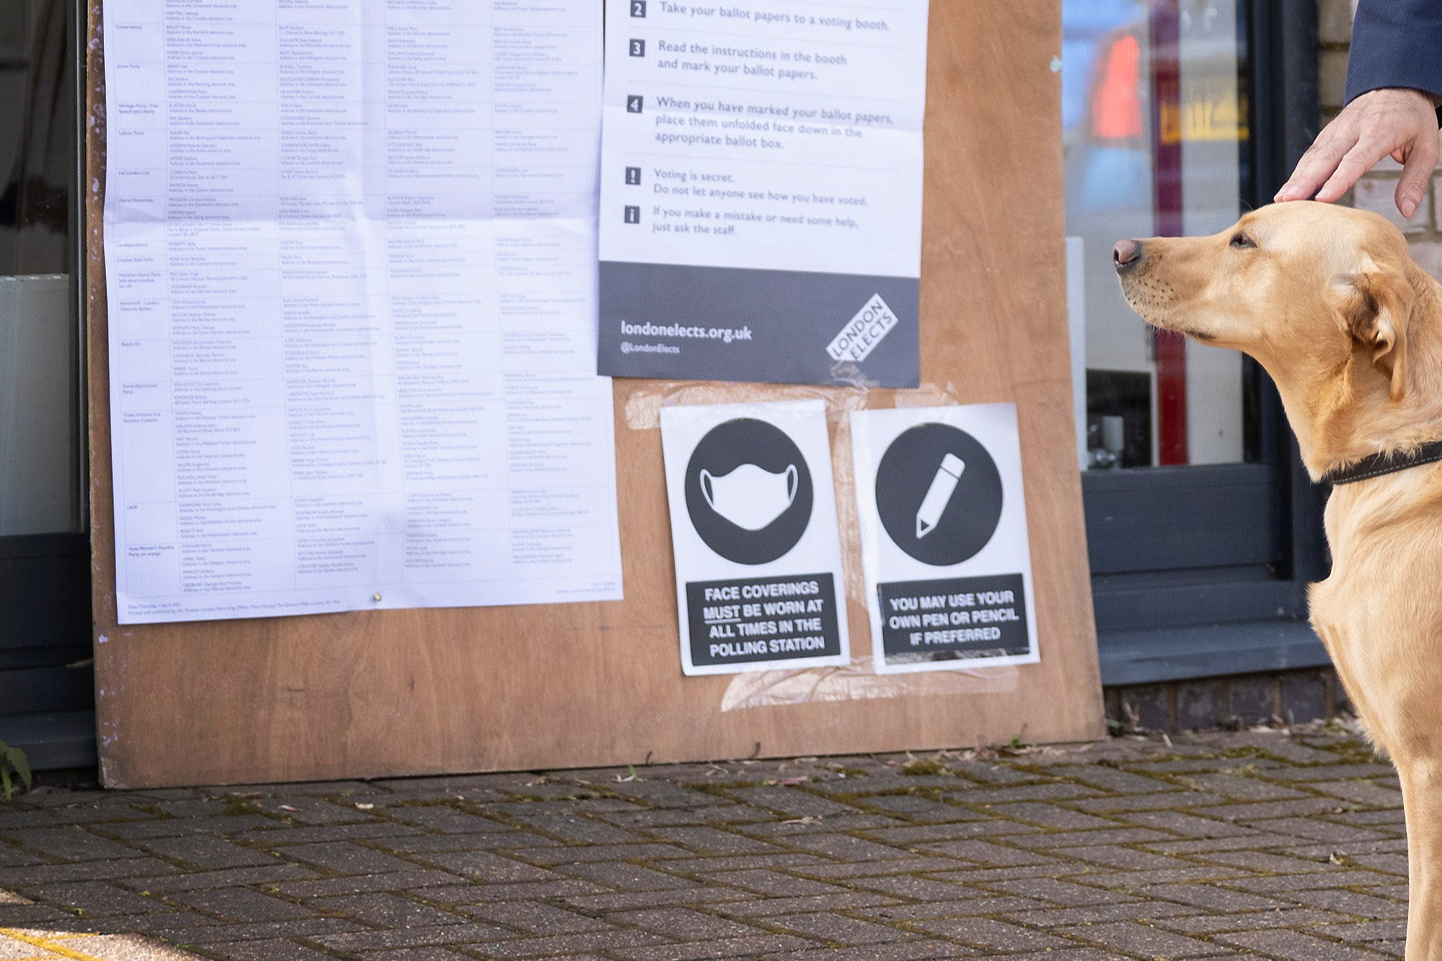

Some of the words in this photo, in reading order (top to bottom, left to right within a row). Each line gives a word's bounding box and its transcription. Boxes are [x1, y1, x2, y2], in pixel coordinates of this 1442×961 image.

[659, 0, 686, 13] Take
[690, 6, 715, 17] your
[719, 5, 750, 18] ballot
[753, 11, 790, 23] papers
[793, 13, 806, 23] to
[808, 16, 815, 24] a
[818, 16, 852, 30] voting
[658, 39, 686, 52] Read
[689, 42, 708, 54] the
[711, 44, 777, 59] instructions
[779, 49, 790, 60] in
[793, 50, 811, 62] the
[814, 51, 847, 64] booth
[657, 57, 678, 68] and
[681, 60, 710, 71] mark
[714, 64, 739, 74] your
[743, 63, 774, 76] ballot
[656, 95, 690, 108] When
[693, 101, 714, 112] you
[717, 100, 743, 112] have
[746, 103, 789, 115] marked
[792, 108, 817, 119] your
[820, 107, 851, 120] ballot
[655, 112, 685, 126] place
[688, 115, 717, 127] them
[720, 117, 769, 130] unfolded
[772, 120, 794, 132] face
[797, 122, 828, 134] down
[831, 125, 842, 136] in
[844, 125, 862, 137] the
[654, 132, 721, 145] appropriate
[725, 133, 757, 146] ballot
[653, 167, 687, 182] Voting
[689, 171, 698, 180] is
[653, 183, 669, 193] Do
[671, 186, 689, 194] not
[692, 185, 705, 195] let
[708, 189, 745, 199] anyone
[748, 191, 764, 199] see
[767, 190, 788, 200] how
[791, 194, 809, 203] you
[812, 193, 834, 203] have
[652, 205, 660, 215] If
[662, 209, 681, 218] you
[684, 208, 711, 218] make
[723, 210, 762, 221] mistake
[765, 214, 776, 222] or
[779, 213, 804, 223] need
[806, 217, 832, 225] some
[652, 222, 670, 233] just
[673, 222, 690, 232] ask
[693, 223, 709, 233] the
[620, 320, 752, 342] londonelects.org.uk
[832, 300, 883, 357] LONDON
[850, 312, 892, 360] ELECTS
[704, 586, 740, 600] FACE
[741, 581, 819, 598] COVERINGS
[889, 597, 918, 610] YOU
[918, 595, 946, 608] MAY
[947, 593, 975, 606] USE
[975, 590, 1014, 604] YOUR
[702, 605, 741, 619] MUST
[742, 603, 762, 616] BE
[762, 600, 805, 615] WORN
[806, 599, 823, 612] AT
[888, 614, 921, 628] OWN
[921, 612, 949, 626] PEN
[949, 611, 970, 624] OR
[970, 607, 1019, 623] PENCIL
[707, 624, 736, 638] ALL
[735, 620, 777, 636] TIMES
[778, 619, 793, 632] IN
[793, 617, 822, 631] THE
[909, 631, 922, 645] IF
[923, 627, 1001, 644] PREFERRED
[709, 640, 767, 656] POLLING
[768, 636, 825, 652] STATION
